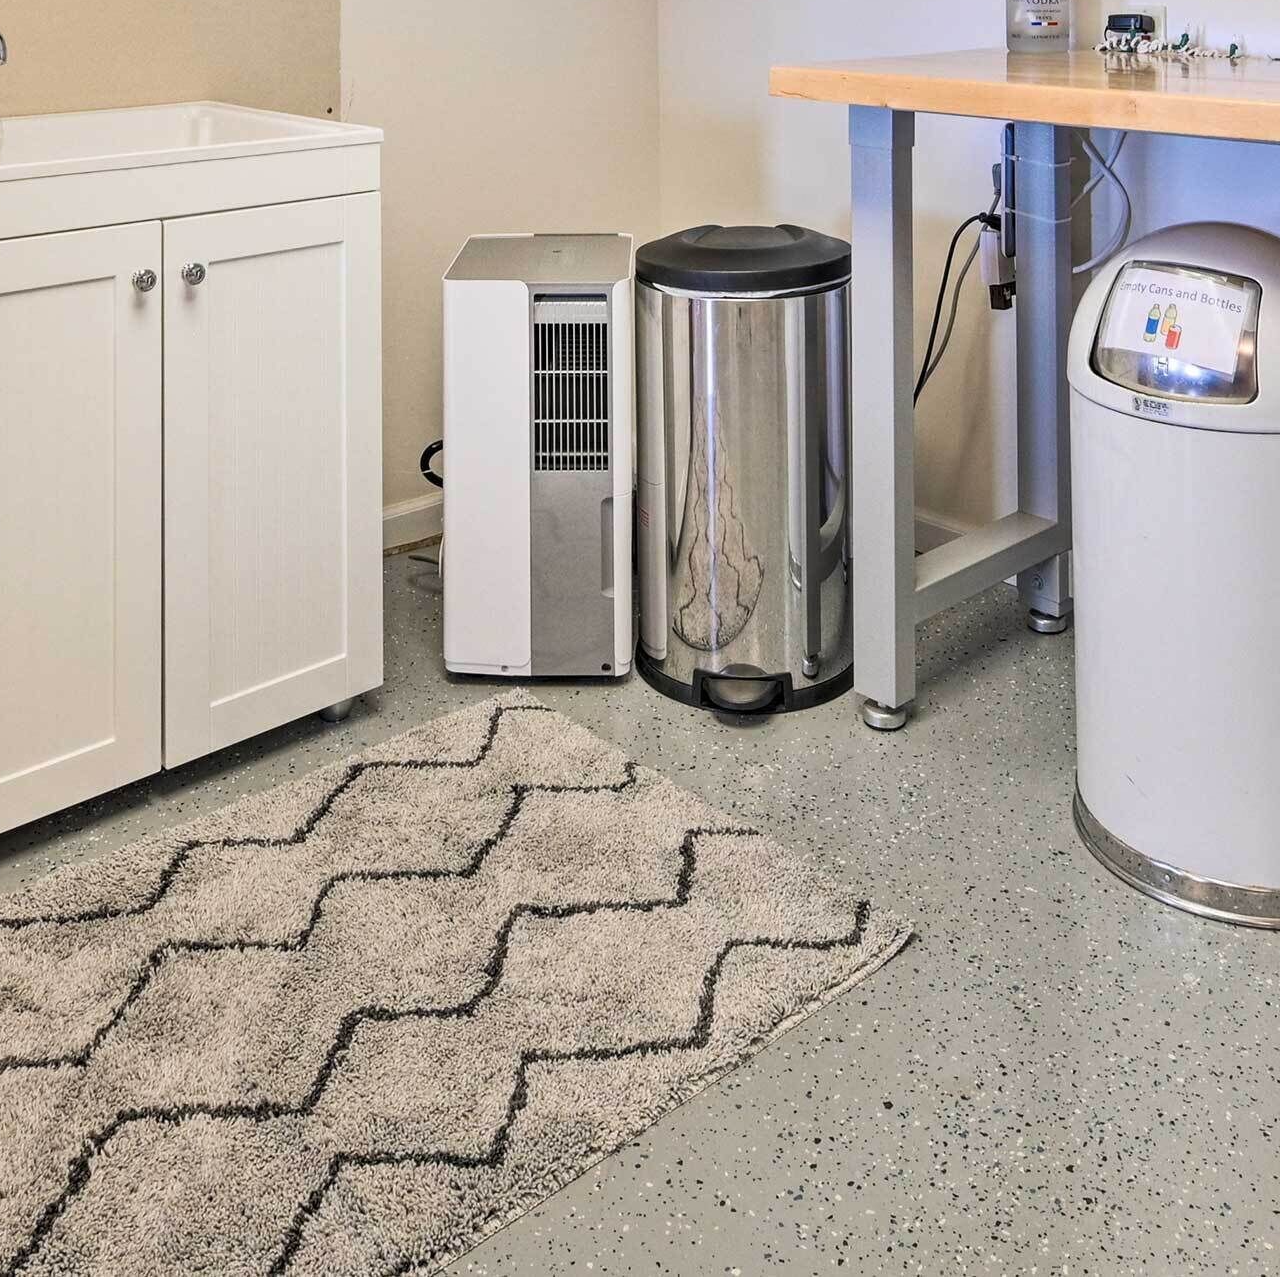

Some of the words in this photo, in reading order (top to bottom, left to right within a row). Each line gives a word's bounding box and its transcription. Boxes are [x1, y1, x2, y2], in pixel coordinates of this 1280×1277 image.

[1120, 282, 1147, 294] Empty
[1149, 283, 1174, 297] Cans
[1175, 289, 1198, 302] and
[1200, 293, 1243, 313] Bottles
